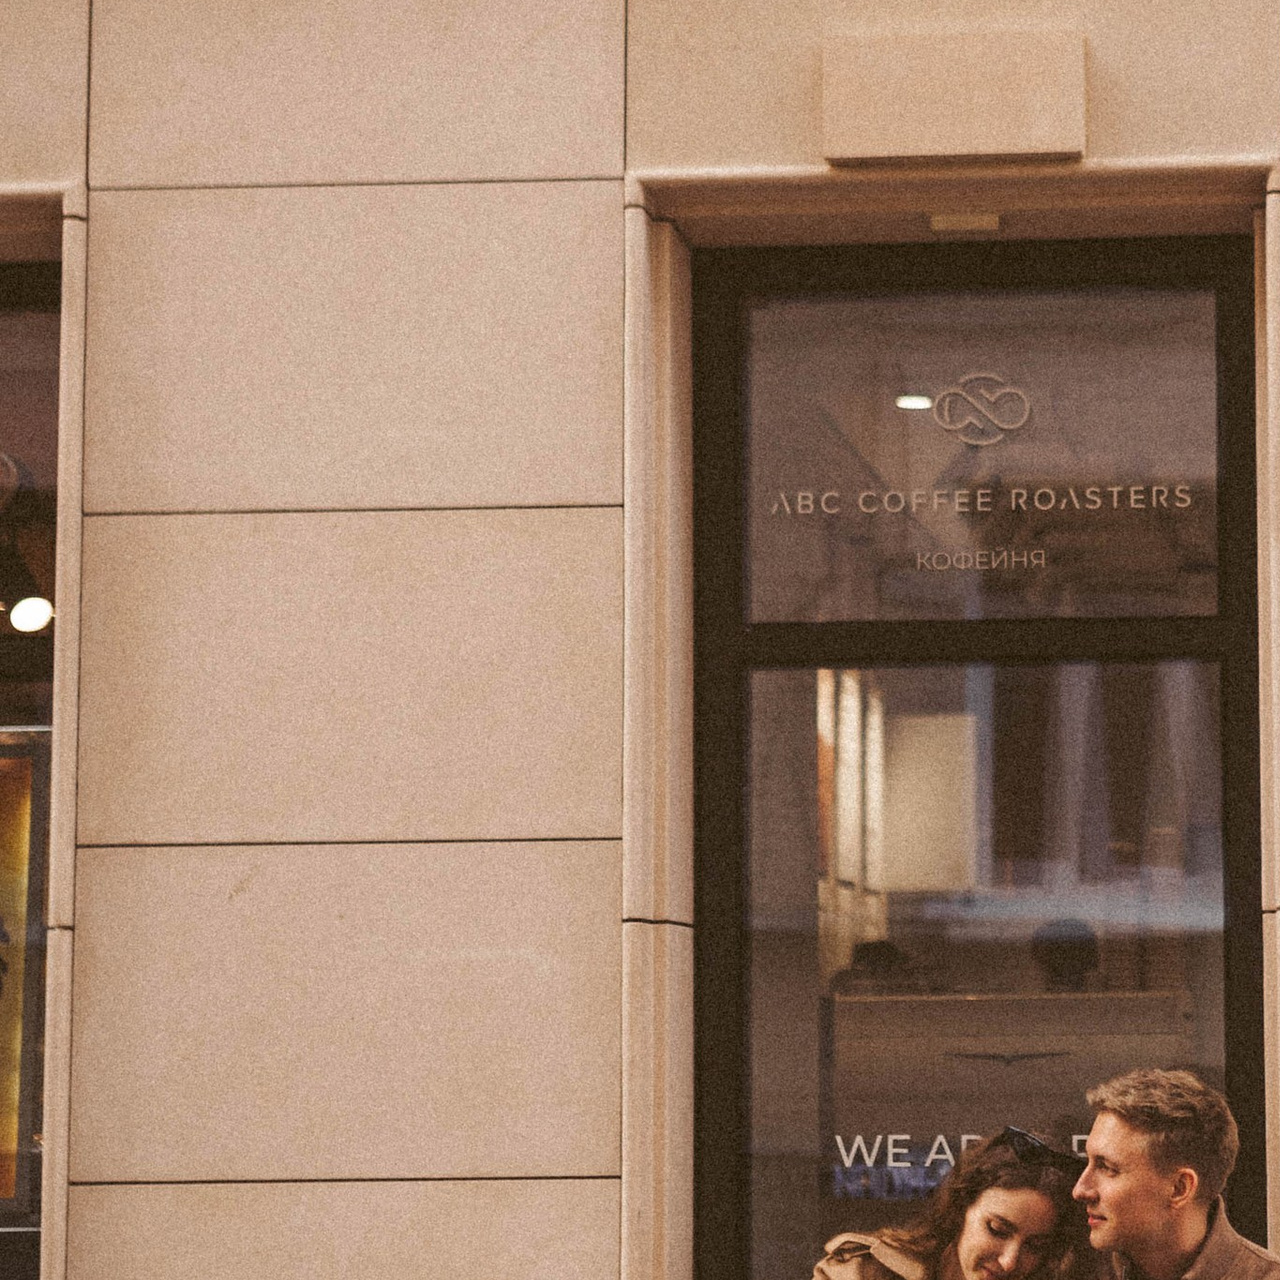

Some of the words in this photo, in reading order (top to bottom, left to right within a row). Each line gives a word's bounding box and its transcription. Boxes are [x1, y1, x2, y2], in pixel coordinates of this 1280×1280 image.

[771, 491, 840, 515] ABC
[858, 489, 993, 514] COFFEE
[1011, 485, 1193, 511] ROASTERS
[916, 547, 1046, 572] КОФЕЙНЯ
[835, 1134, 912, 1168] WE
